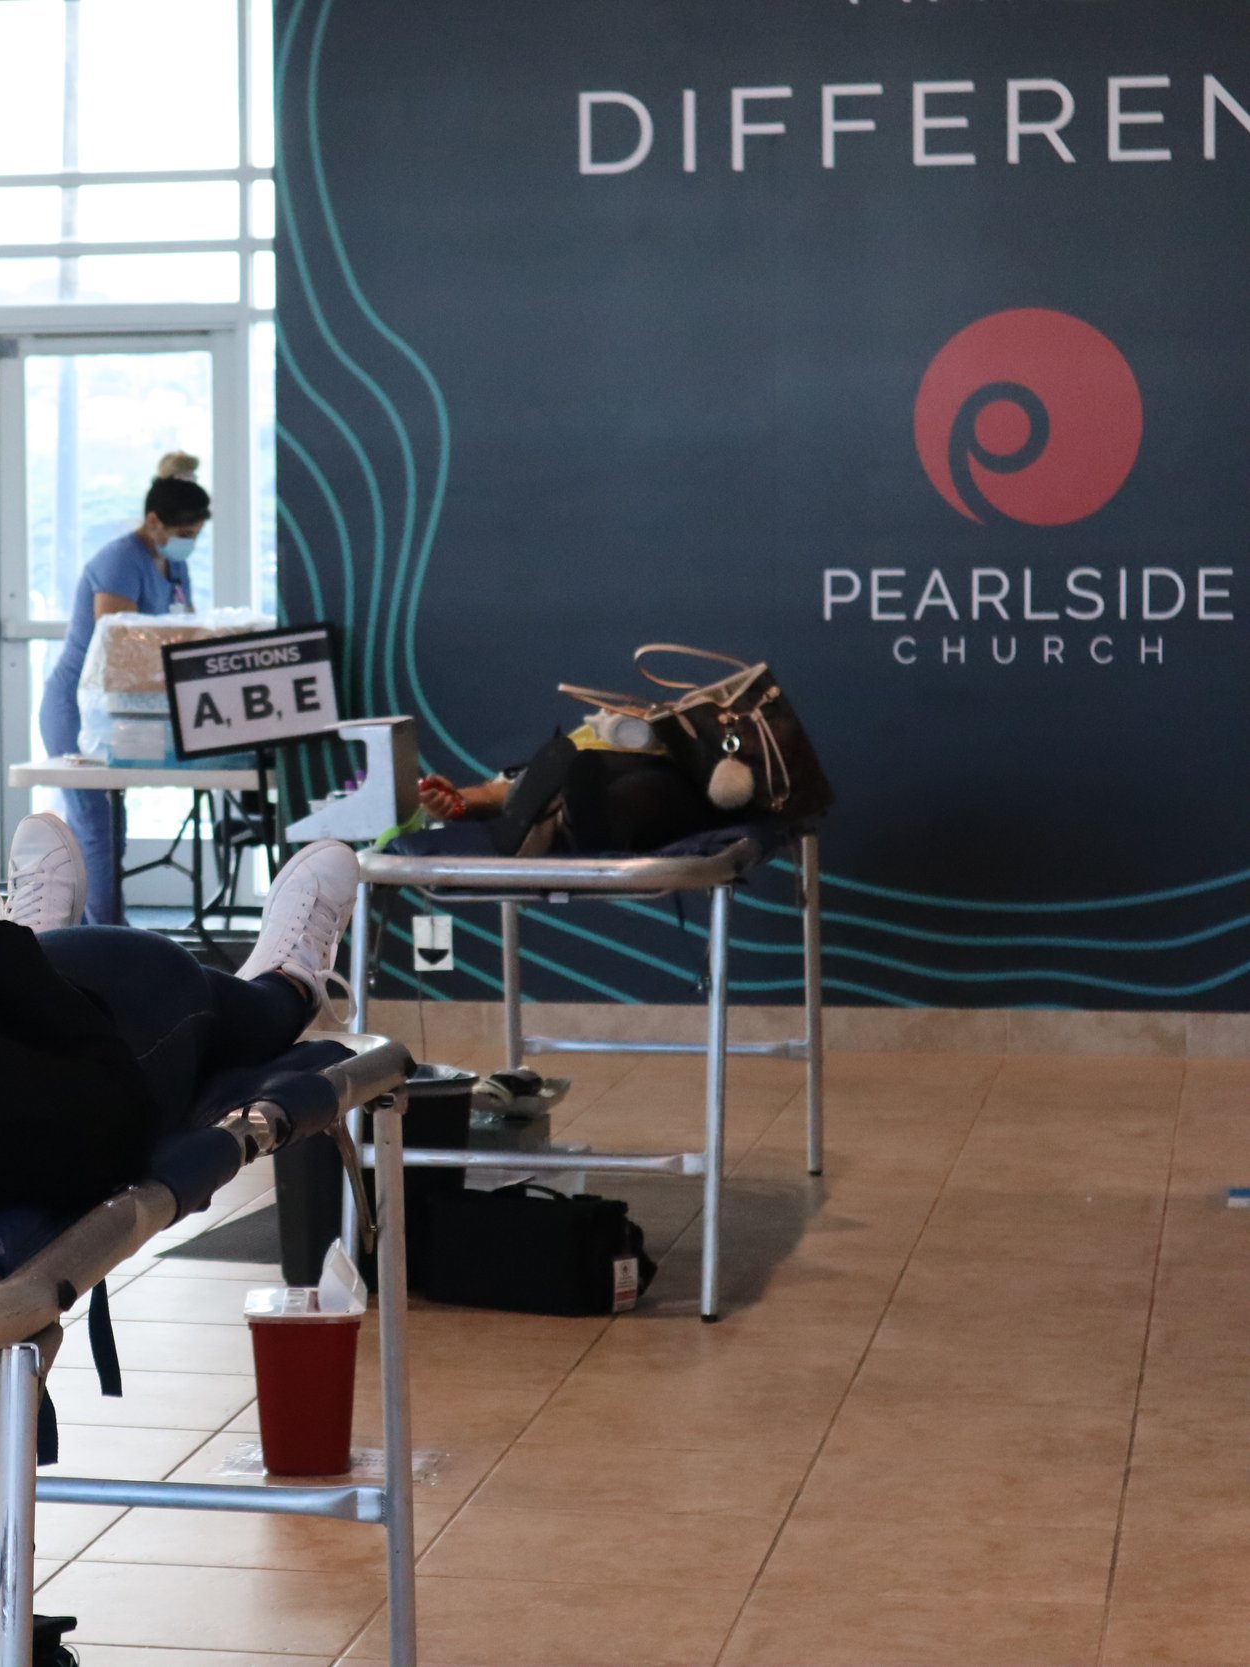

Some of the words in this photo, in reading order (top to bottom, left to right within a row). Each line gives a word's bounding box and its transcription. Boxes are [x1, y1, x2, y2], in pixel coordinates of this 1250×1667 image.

[823, 567, 1235, 621] PEARLSIDE
[205, 646, 301, 674] SECTIONS
[892, 636, 1164, 665] CHURCH
[193, 691, 231, 729] A,
[241, 684, 283, 721] B,
[293, 676, 321, 713] E
